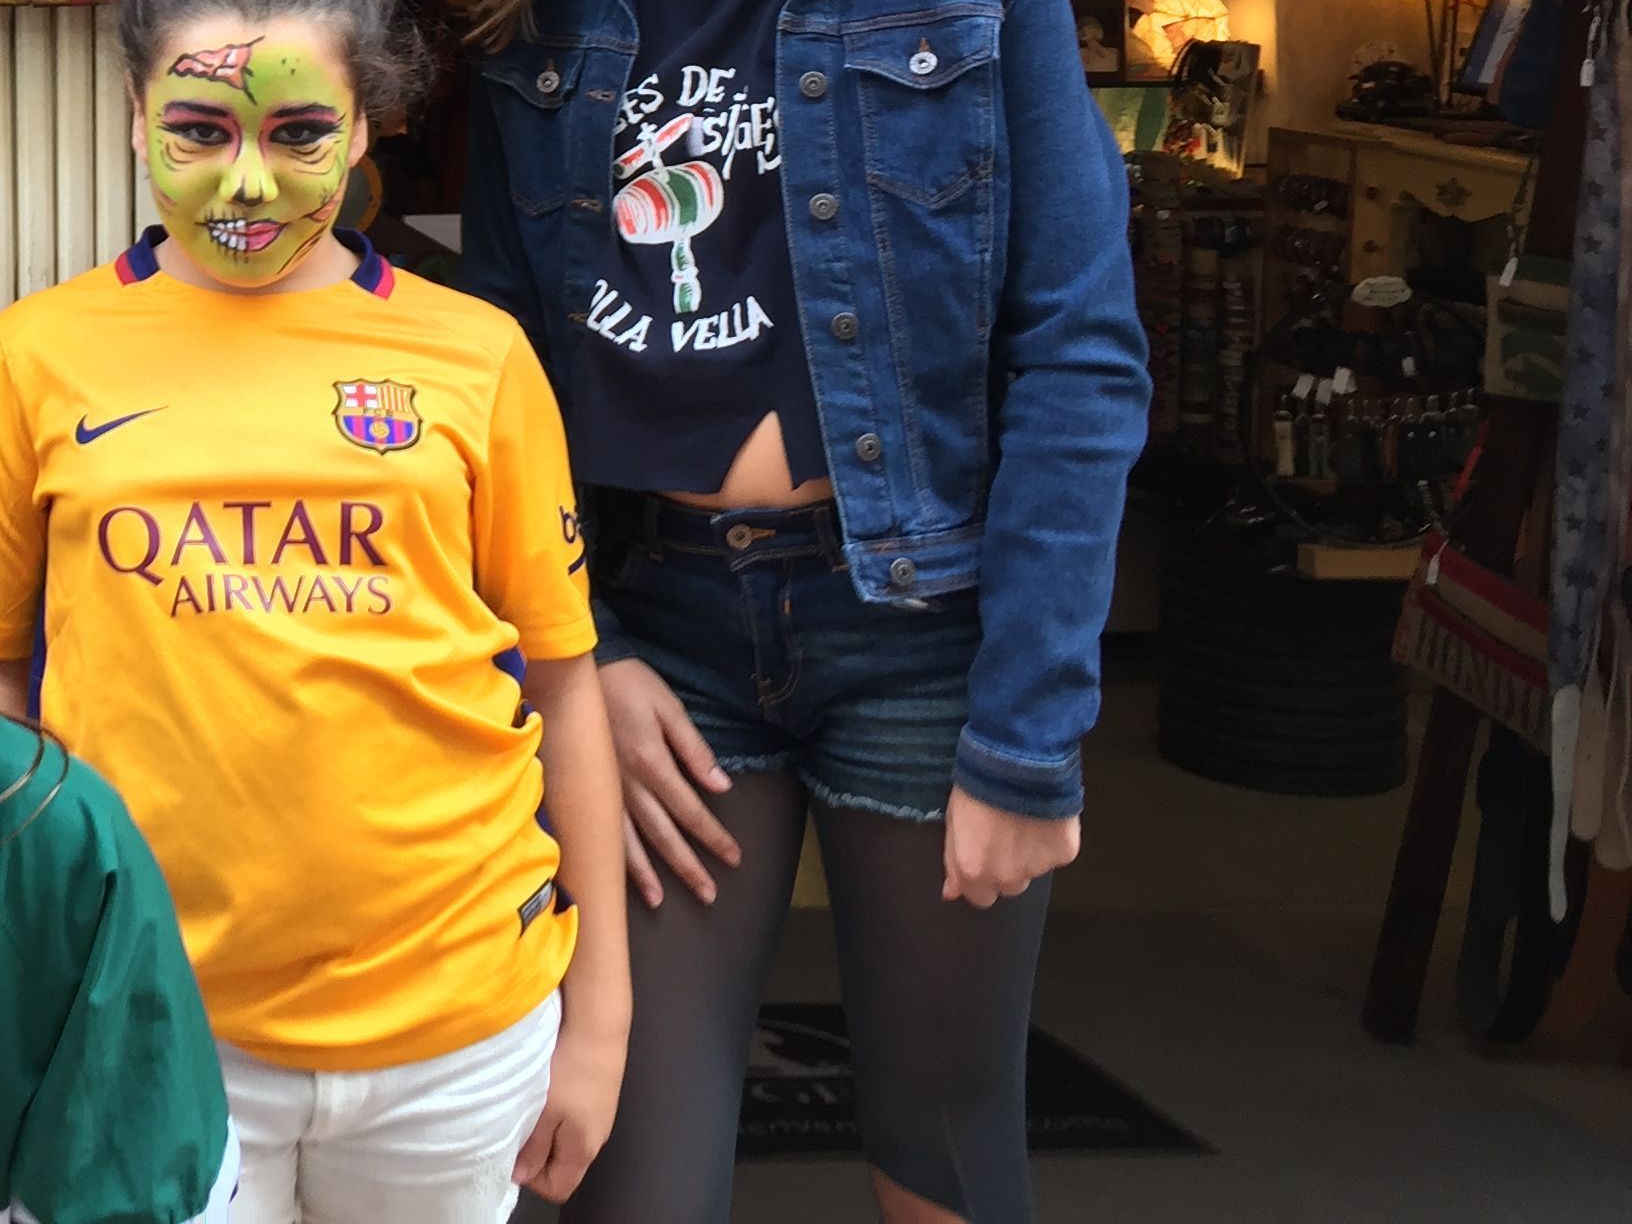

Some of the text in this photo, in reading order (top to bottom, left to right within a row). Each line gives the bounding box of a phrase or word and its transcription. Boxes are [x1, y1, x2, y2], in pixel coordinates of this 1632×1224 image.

[675, 64, 737, 107] DE
[670, 295, 775, 353] VELLA
[97, 499, 389, 586] QATAR
[170, 573, 392, 617] AIRWAYS
